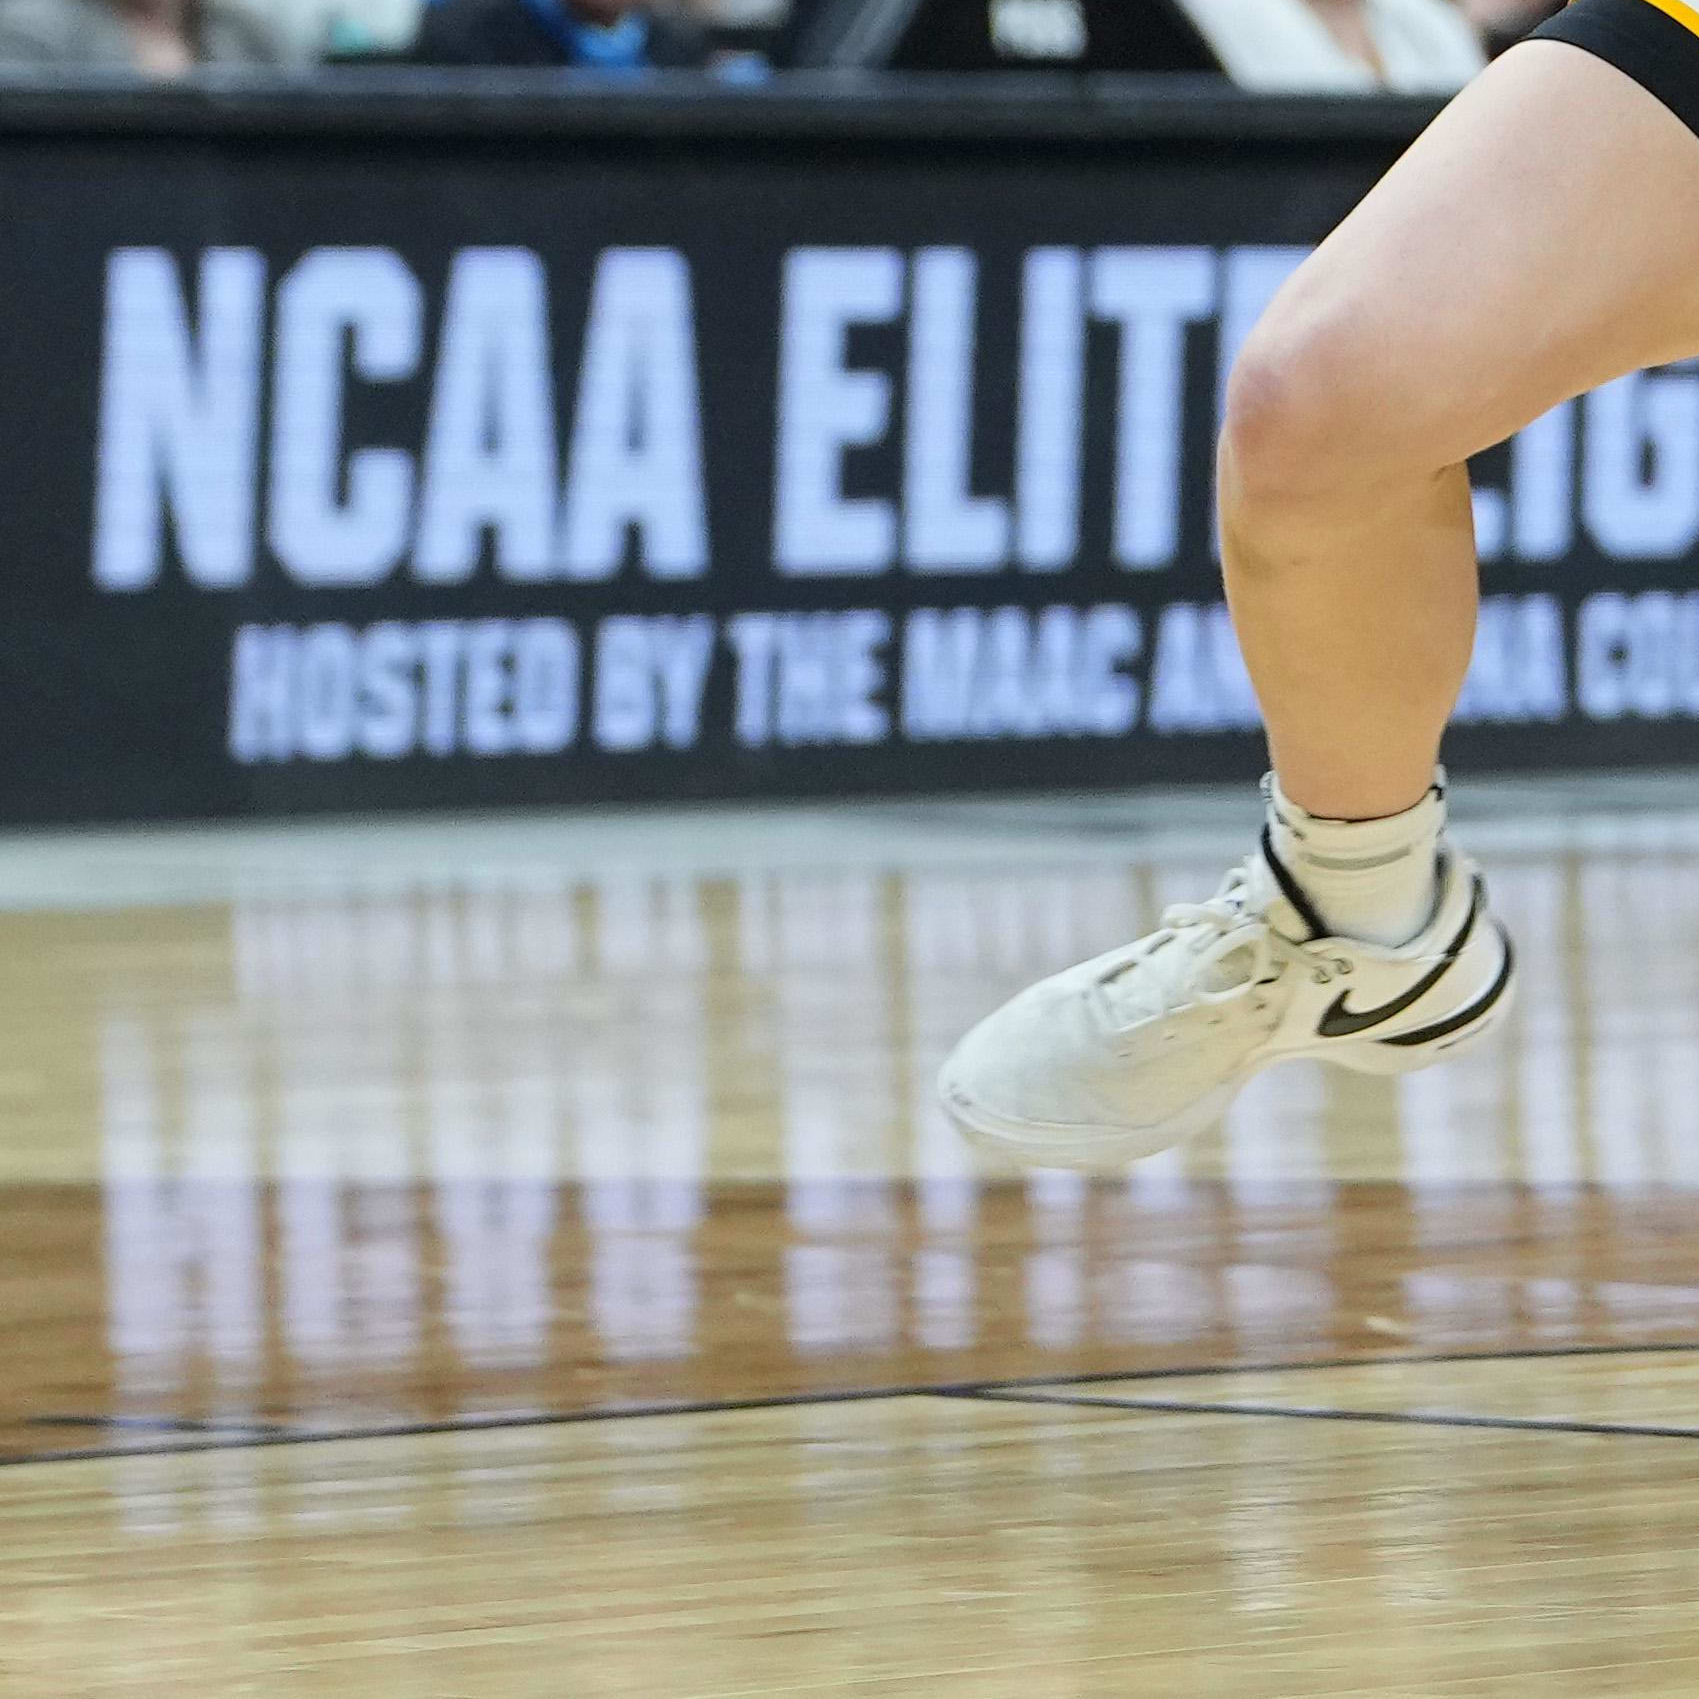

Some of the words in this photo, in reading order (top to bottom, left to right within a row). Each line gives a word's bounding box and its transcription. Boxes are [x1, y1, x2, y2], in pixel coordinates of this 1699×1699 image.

[94, 246, 706, 589] NCAA
[230, 623, 581, 760] HOSTED
[594, 615, 713, 747] BY
[730, 609, 893, 744] THE
[902, 603, 1141, 739] MAAC
